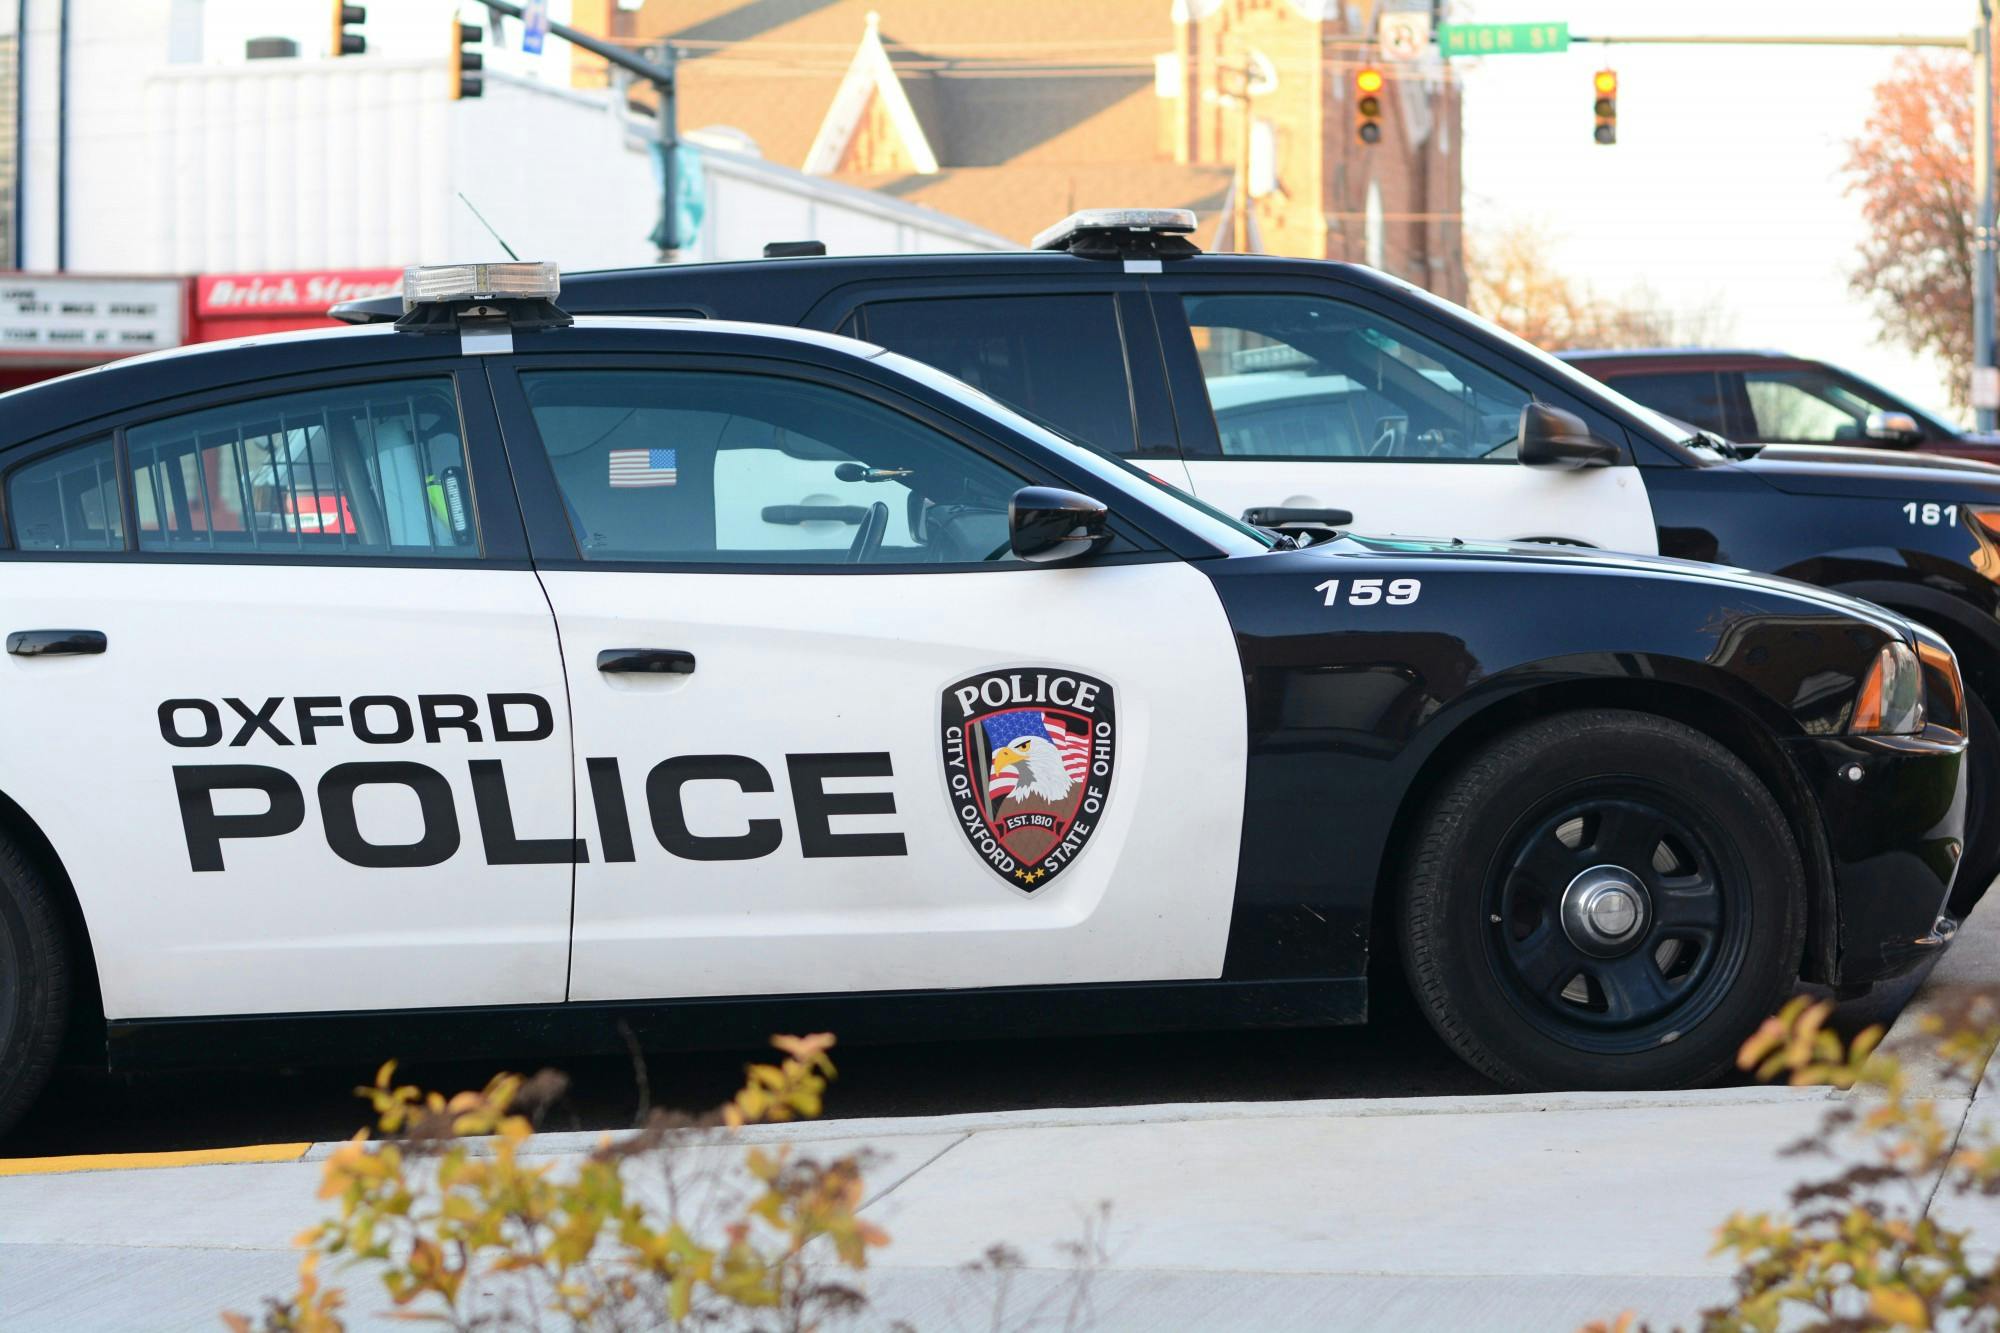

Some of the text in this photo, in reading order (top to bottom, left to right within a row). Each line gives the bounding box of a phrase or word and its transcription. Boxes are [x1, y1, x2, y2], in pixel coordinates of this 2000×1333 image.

[1449, 27, 1559, 49] HIGH ST
[207, 279, 296, 307] Brick
[1313, 578, 1422, 606] 159
[954, 674, 1101, 717] POLICE
[157, 692, 555, 748] OXFORD
[172, 751, 908, 873] POLICE
[947, 727, 1015, 873] CITY OF OXFORD
[1044, 723, 1111, 872] STATE OF OHIO
[1007, 815, 1053, 829] EST. 1810
